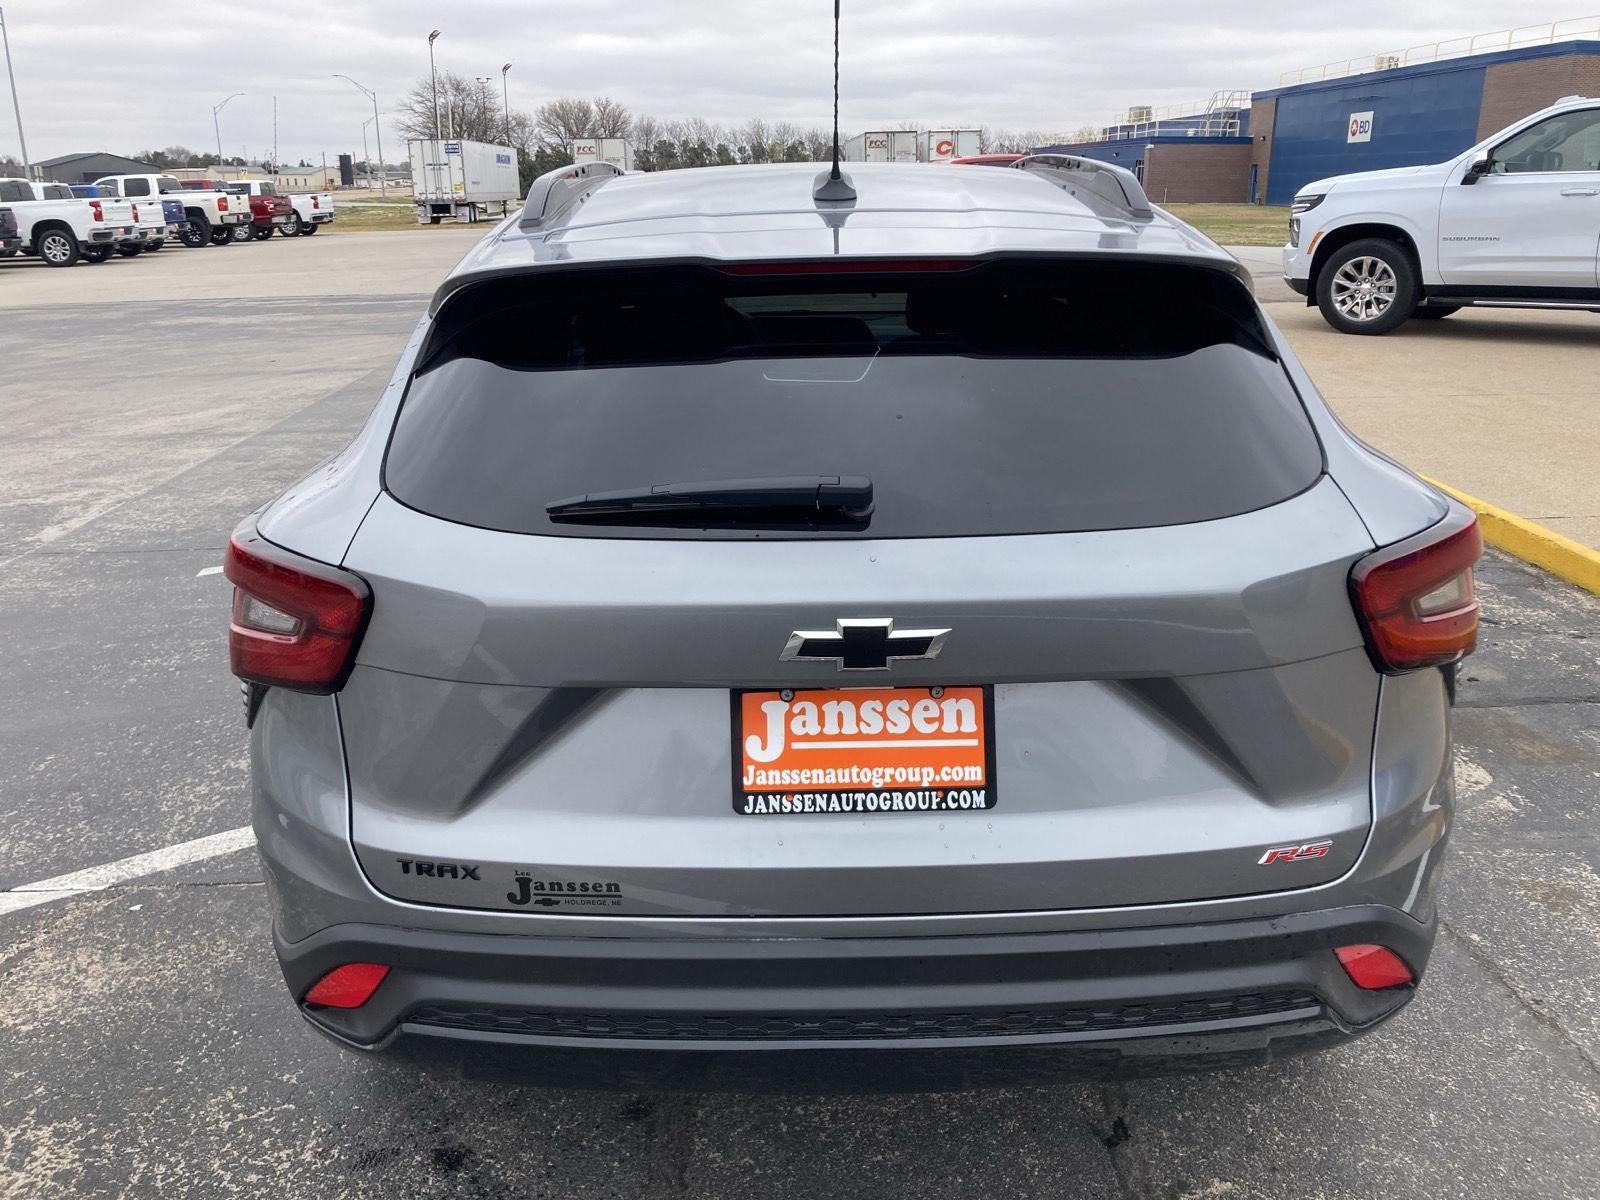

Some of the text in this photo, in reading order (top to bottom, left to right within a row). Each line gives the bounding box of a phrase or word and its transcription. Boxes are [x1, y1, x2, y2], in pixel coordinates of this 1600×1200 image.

[1359, 120, 1370, 134] BD
[745, 698, 977, 762] Janssen
[743, 764, 983, 788] Janssenautogroup.com
[1257, 840, 1333, 865] RS
[397, 858, 481, 881] TRAX
[506, 877, 622, 905] Janssen
